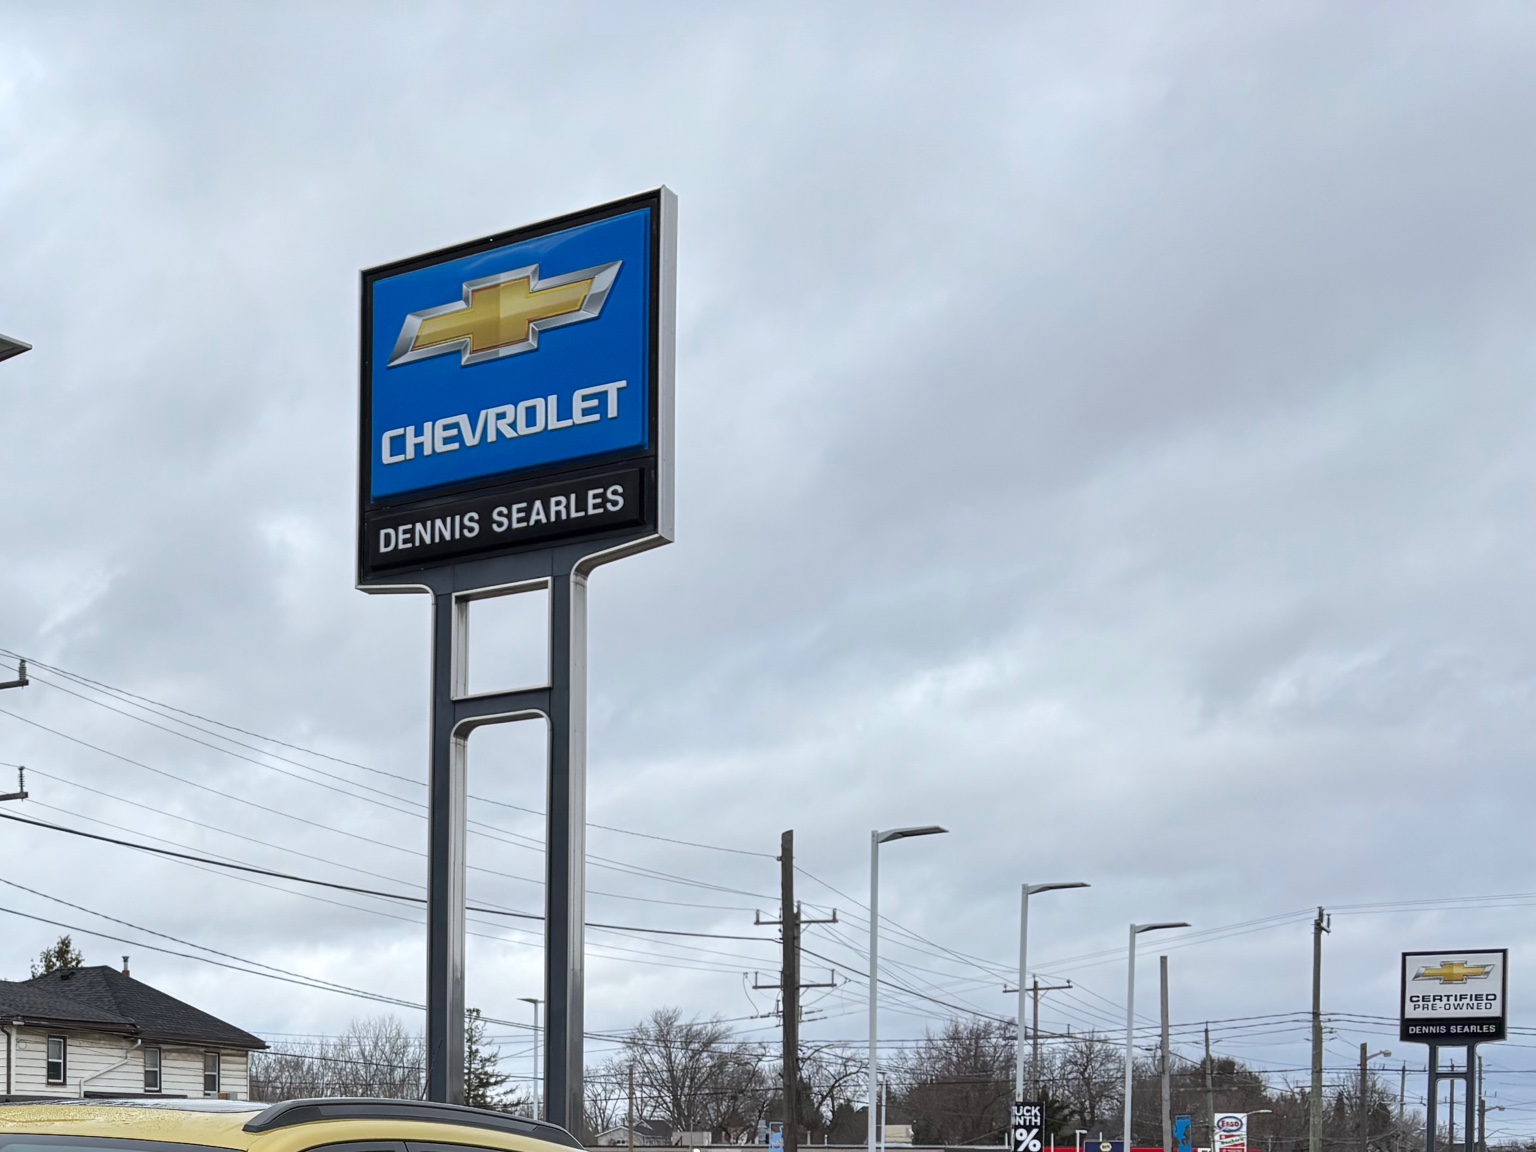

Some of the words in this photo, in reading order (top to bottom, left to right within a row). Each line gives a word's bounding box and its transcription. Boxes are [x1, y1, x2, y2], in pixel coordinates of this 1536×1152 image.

[381, 380, 627, 465] CHEVROLET
[379, 511, 480, 553] DENNIS
[491, 484, 625, 533] SEARLES
[1409, 993, 1497, 1003] CERTIFIED
[1413, 1002, 1493, 1011] PRE-OWNED
[1408, 1025, 1447, 1034] DENNIS
[1450, 1024, 1496, 1033] SEARLES
[1012, 1105, 1041, 1117] UCK
[1013, 1116, 1041, 1126] NTH
